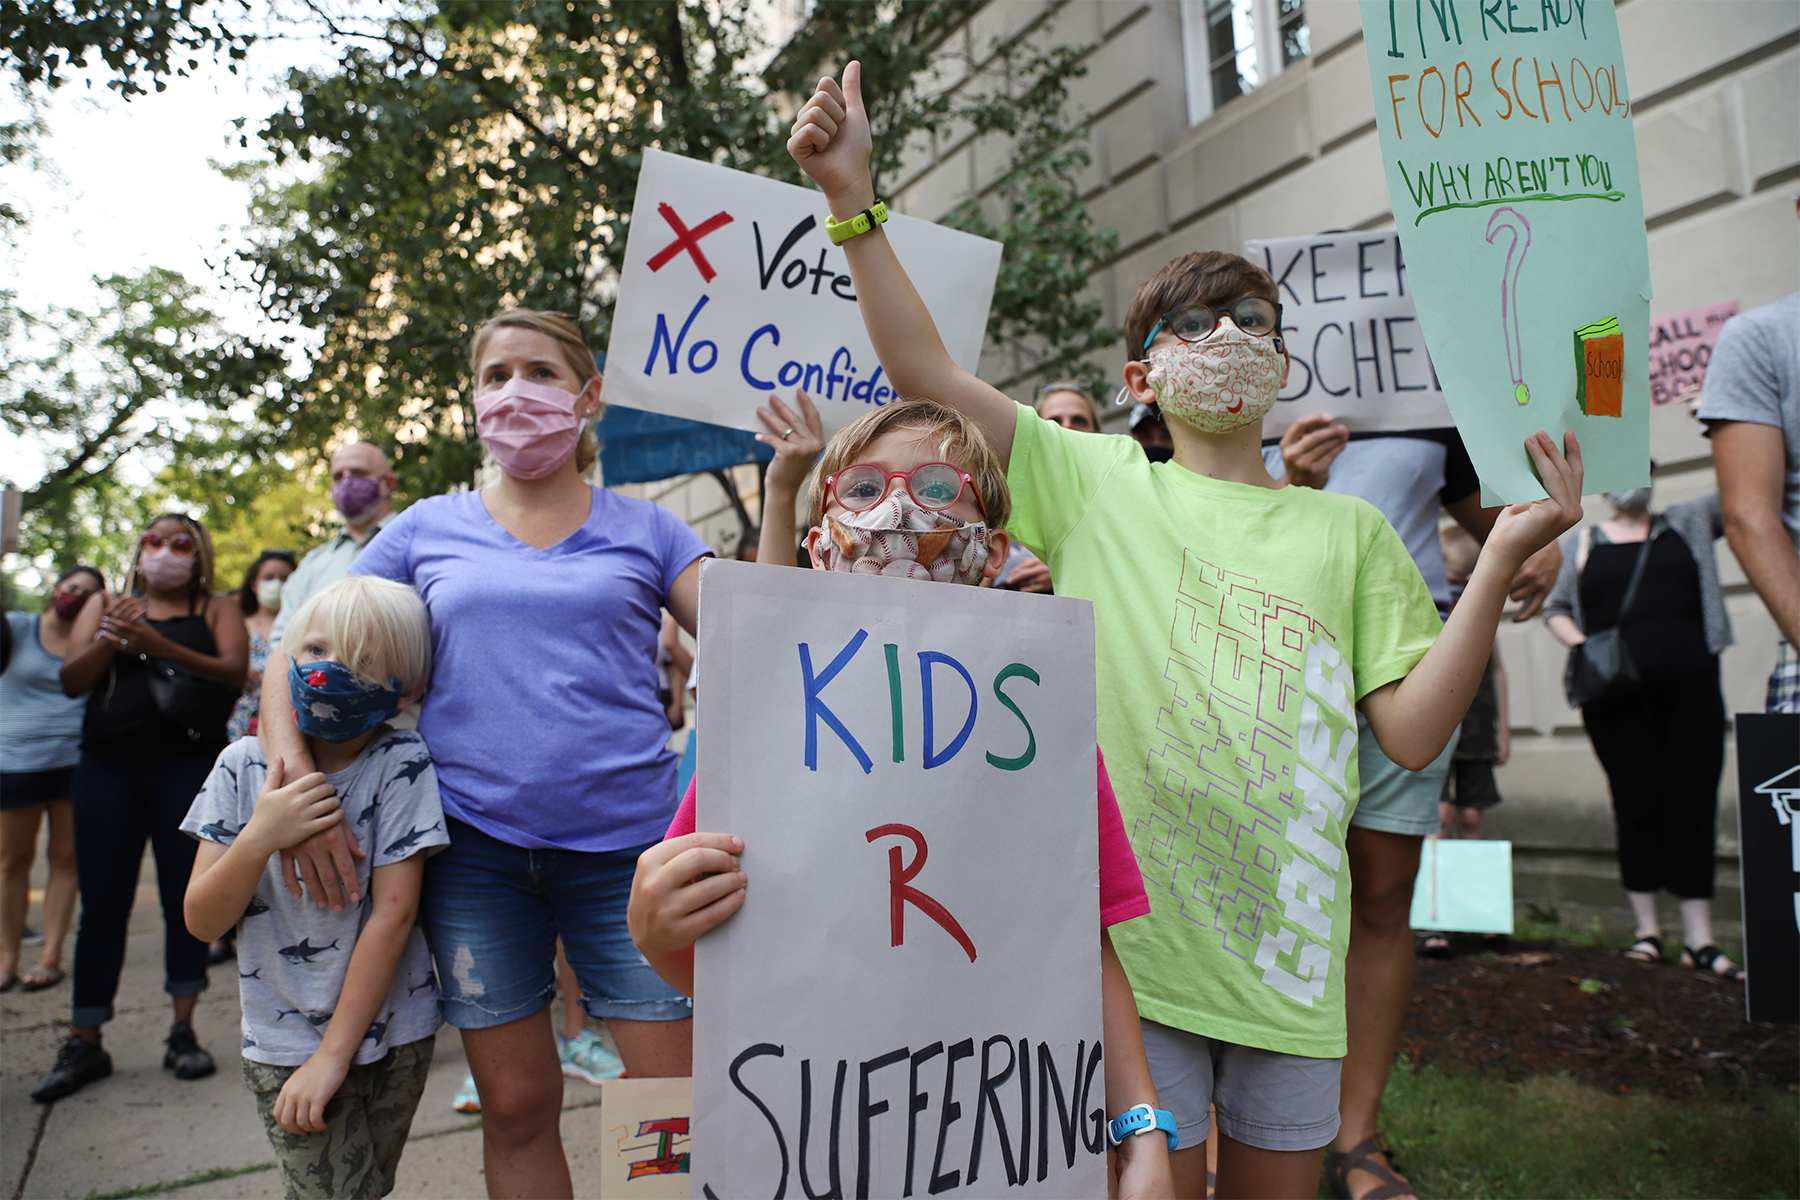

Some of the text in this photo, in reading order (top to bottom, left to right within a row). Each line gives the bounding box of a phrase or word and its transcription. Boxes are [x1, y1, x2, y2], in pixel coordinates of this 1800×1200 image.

[1388, 60, 1481, 140] FOR
[1397, 154, 1613, 208] WHY AREN'T YOU
[752, 214, 858, 301] Vote
[643, 293, 718, 377] No
[1276, 316, 1443, 402] SCHE
[1587, 351, 1621, 385] School
[797, 628, 1041, 775] KIDS
[1253, 633, 1357, 1008] GAMER
[865, 823, 977, 963] R
[702, 1033, 1105, 1200] SUFFERING
